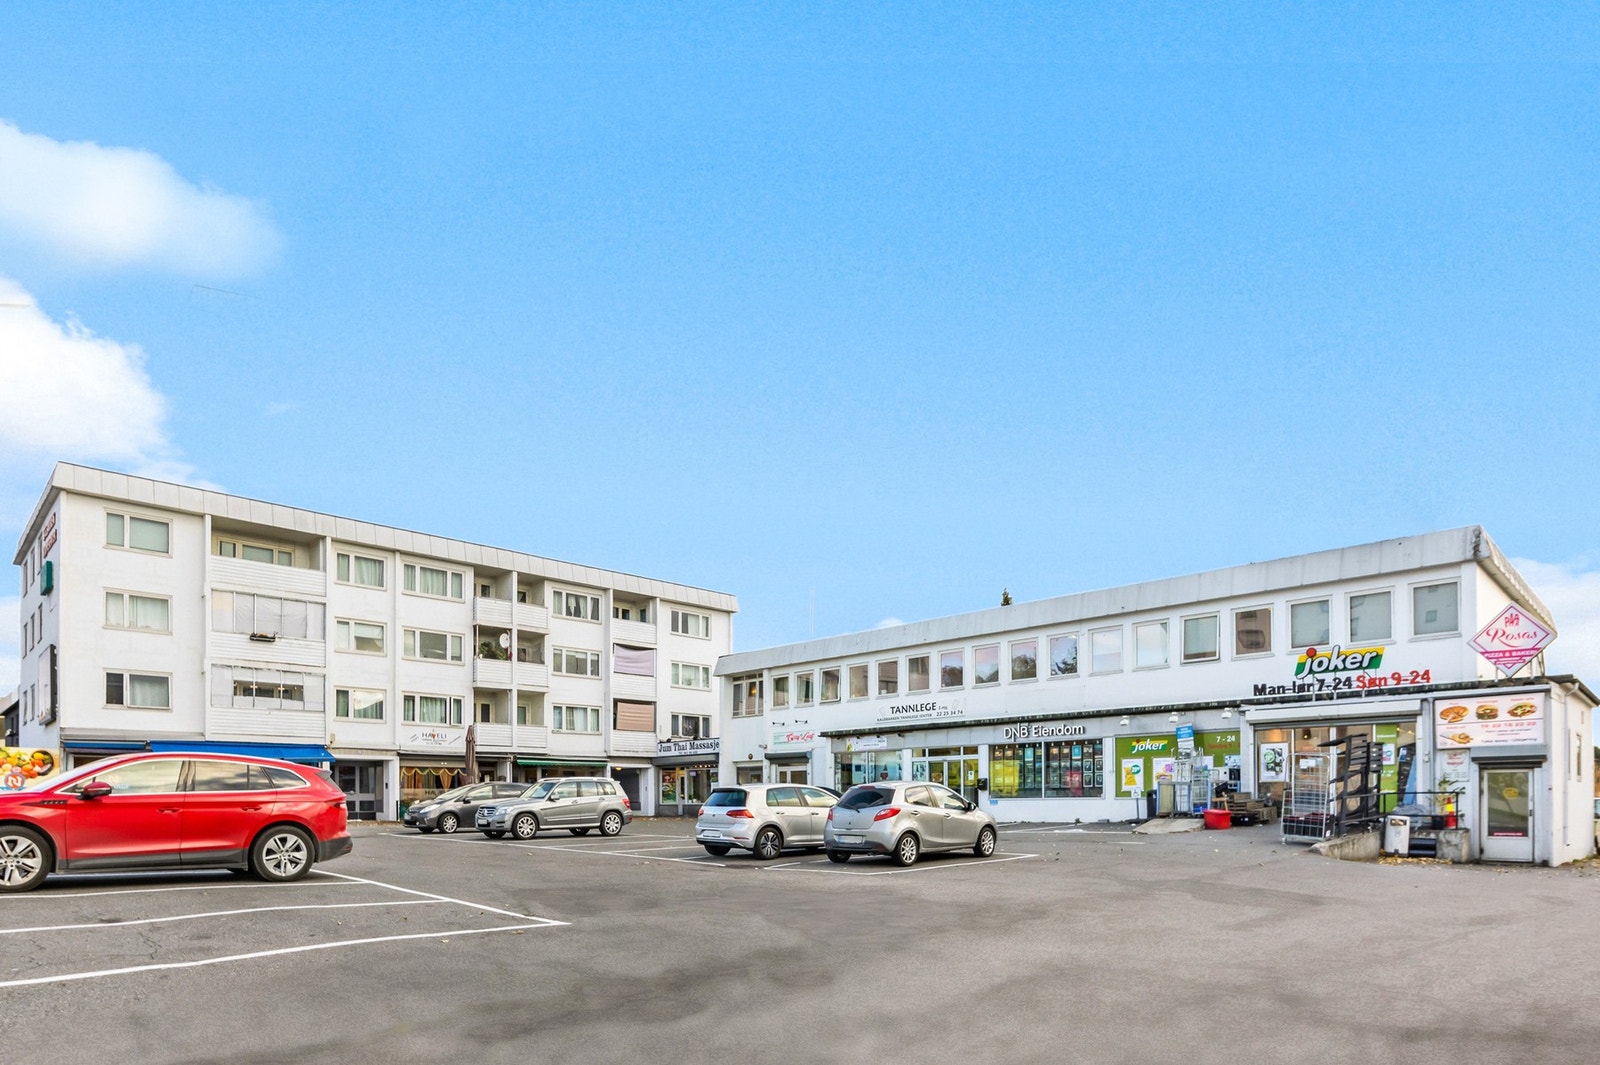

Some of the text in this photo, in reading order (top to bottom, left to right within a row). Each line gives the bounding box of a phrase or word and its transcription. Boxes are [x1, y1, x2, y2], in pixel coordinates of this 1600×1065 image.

[1486, 627, 1537, 648] Rosas
[1296, 645, 1378, 679] joker
[1391, 669, 1431, 686] 9-24
[890, 702, 937, 714] TANNLEGE
[1003, 723, 1083, 741] DNB Eiendom
[1216, 735, 1221, 743] 7
[1227, 735, 1236, 743] 24
[659, 740, 720, 752] Jum Thai Massasje
[1132, 739, 1166, 754] joker
